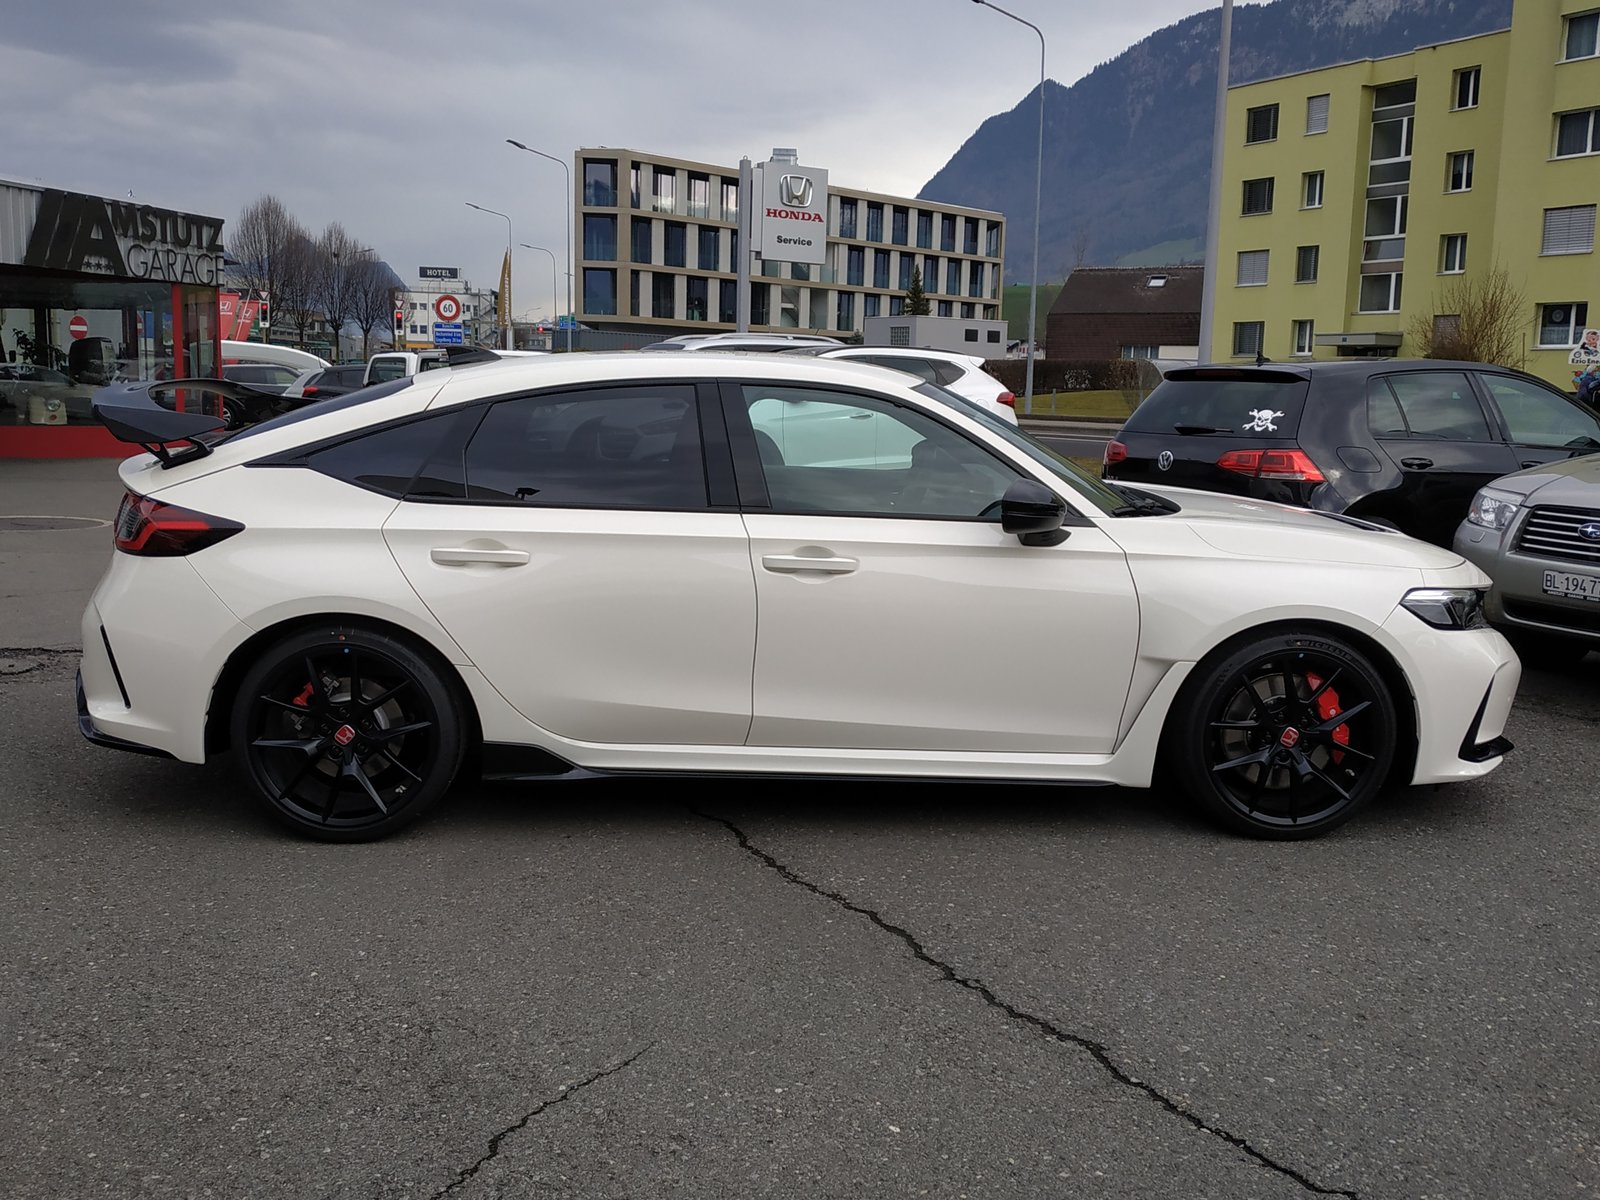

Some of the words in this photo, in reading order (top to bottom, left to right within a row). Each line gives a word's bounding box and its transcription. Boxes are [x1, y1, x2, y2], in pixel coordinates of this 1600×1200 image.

[765, 208, 824, 223] HONDA
[776, 235, 813, 247] Service
[126, 243, 225, 287] GARAGE
[426, 269, 451, 277] HOTEL
[443, 303, 453, 313] 60
